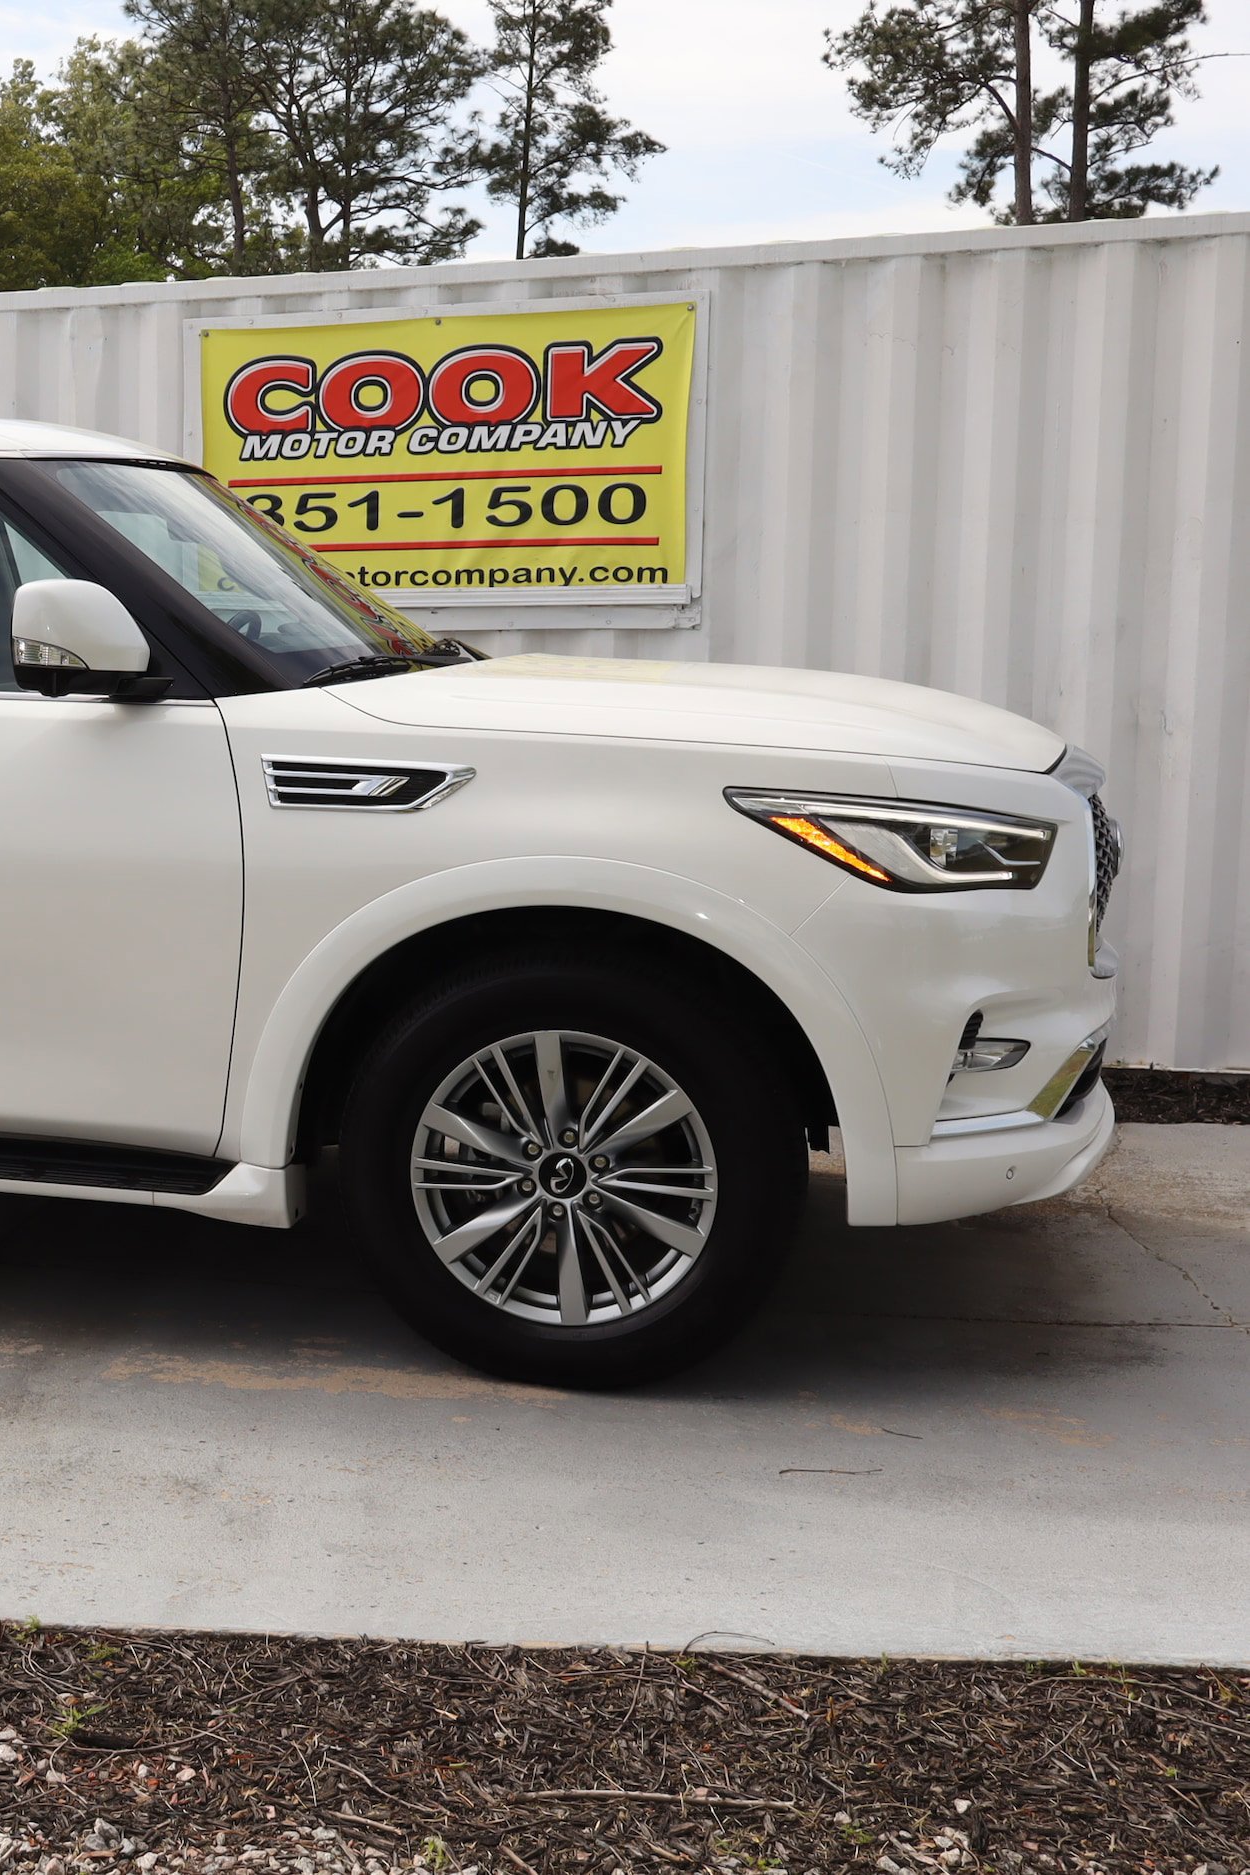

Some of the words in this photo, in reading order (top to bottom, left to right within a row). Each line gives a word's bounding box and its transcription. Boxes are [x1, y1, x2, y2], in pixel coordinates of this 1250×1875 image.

[224, 337, 663, 438] COOK
[239, 427, 398, 461] MOTOR
[407, 418, 643, 455] COMPANY
[345, 566, 668, 587] torcompany.com
